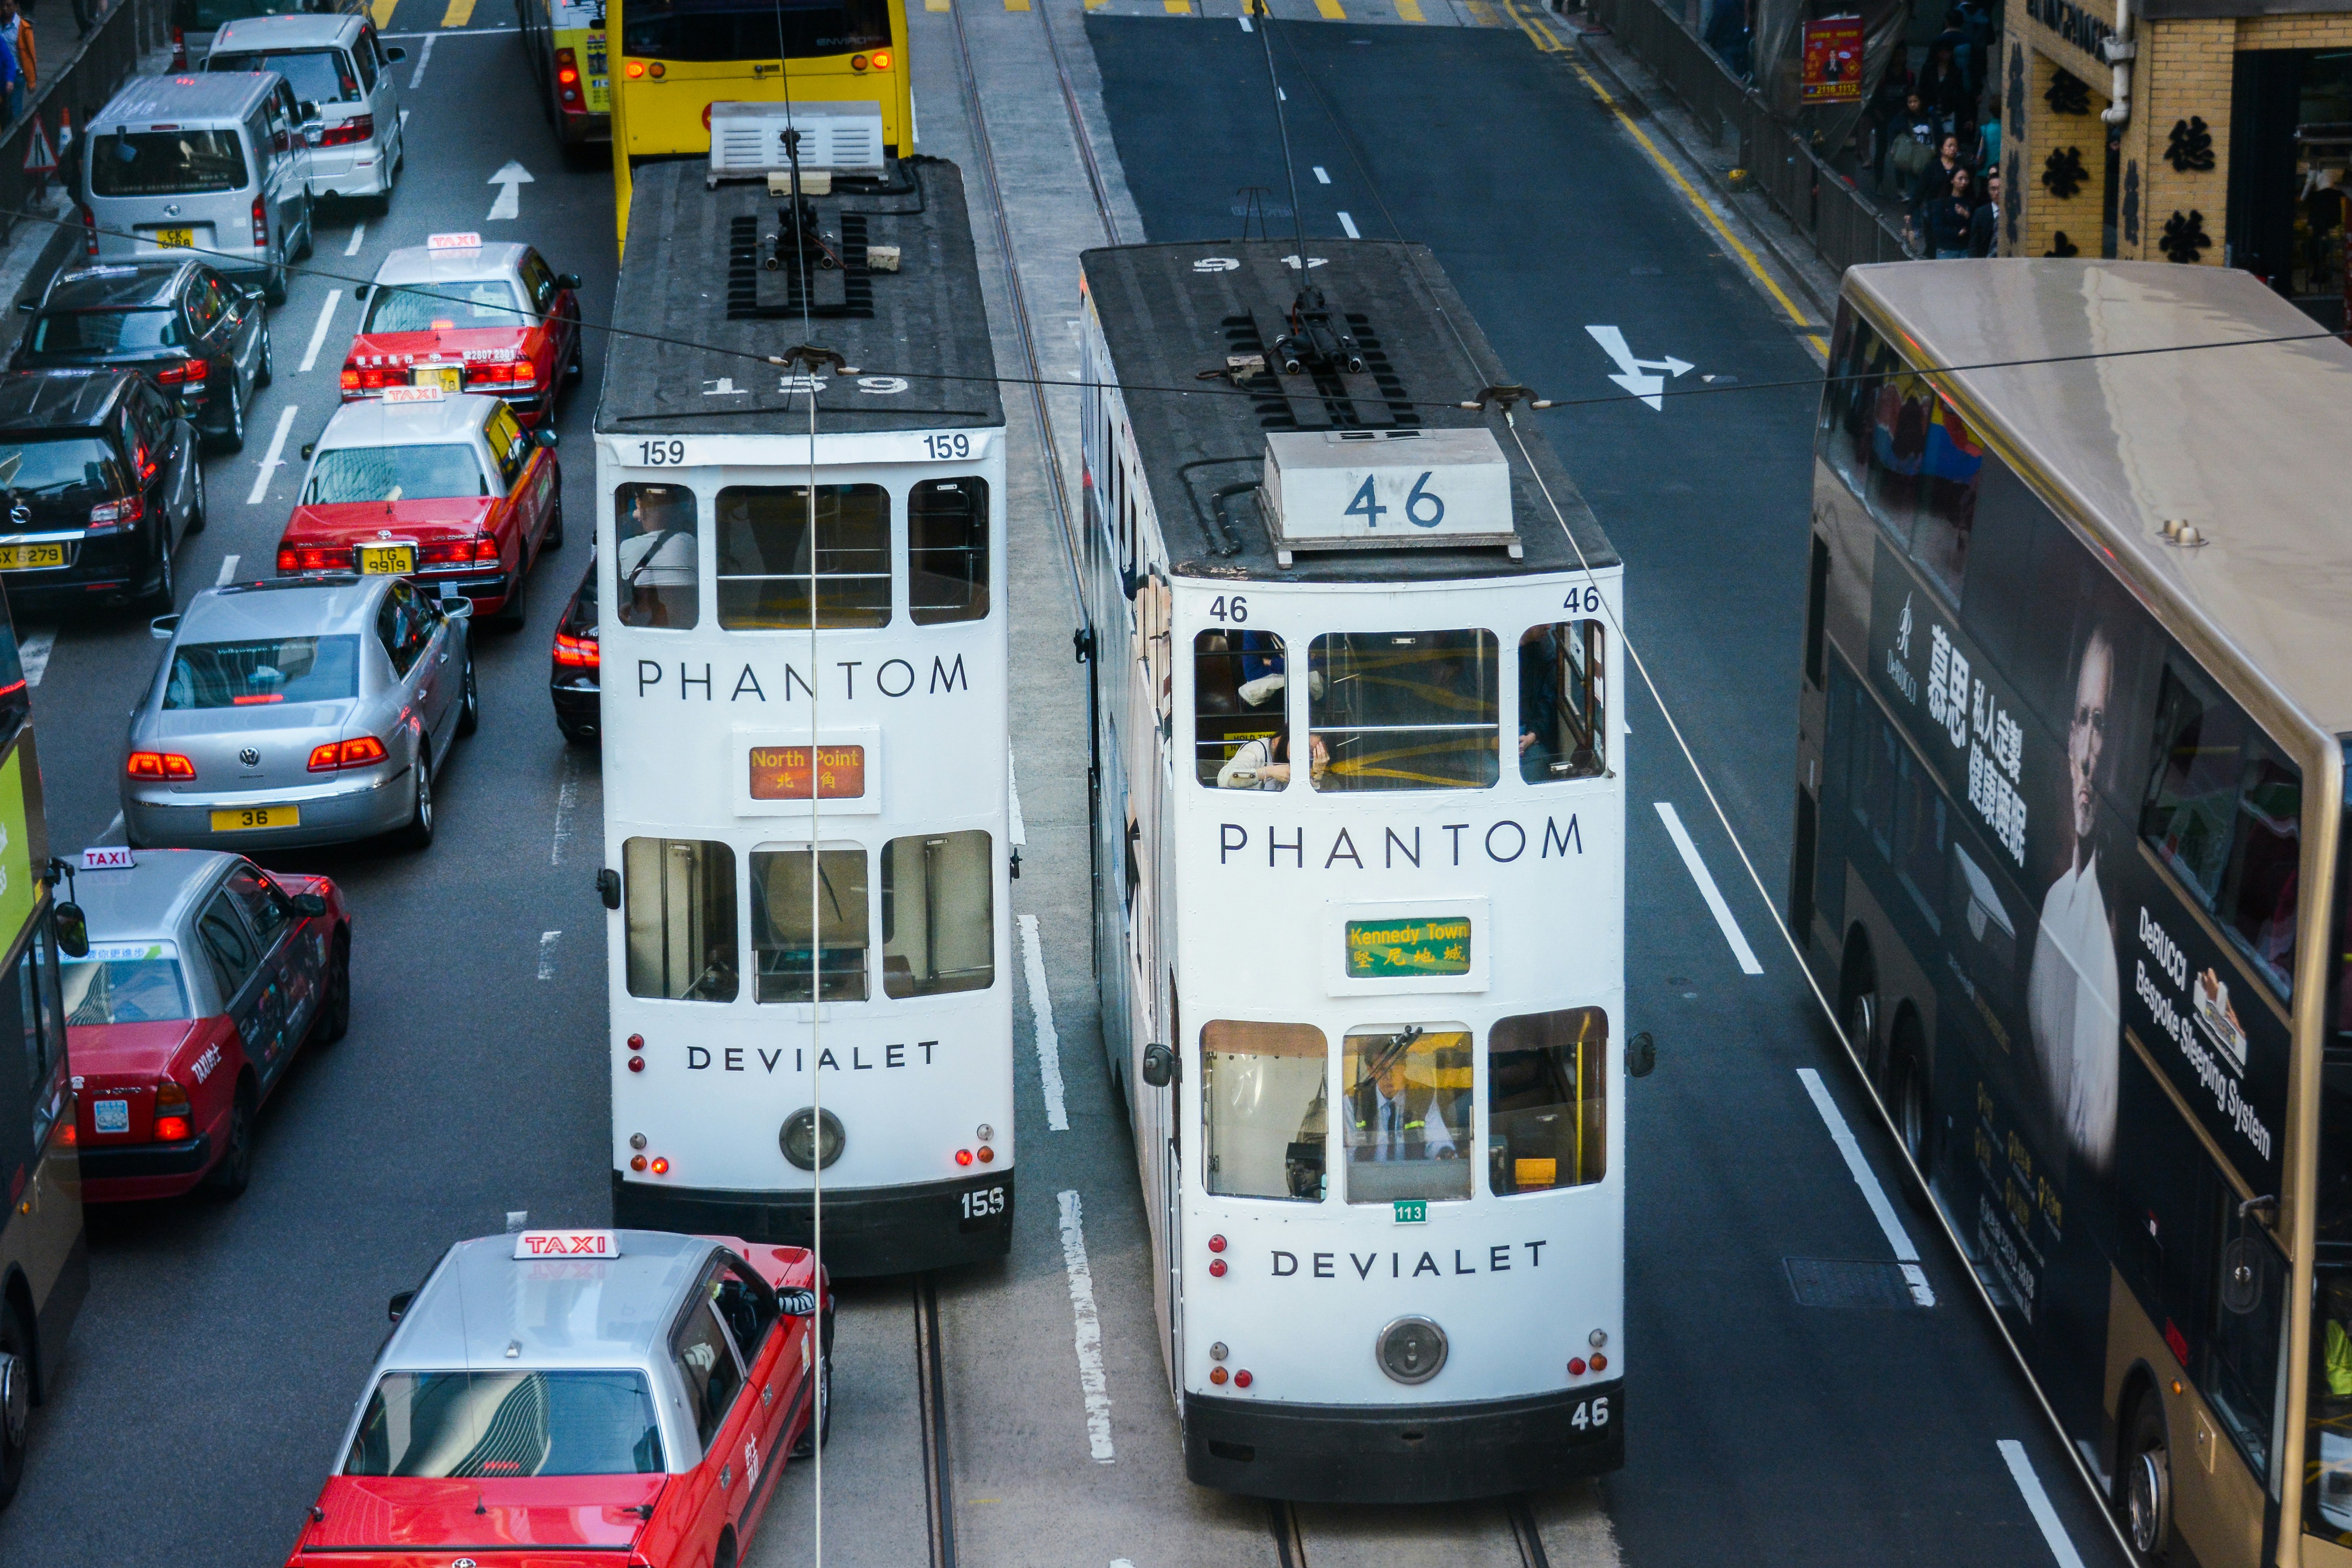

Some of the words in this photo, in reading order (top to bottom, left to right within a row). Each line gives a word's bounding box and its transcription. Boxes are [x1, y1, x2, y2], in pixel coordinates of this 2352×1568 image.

[817, 37, 866, 47] ENVIRO
[168, 231, 182, 239] CK
[433, 236, 475, 246] TAXI
[471, 350, 492, 360] 2807
[494, 349, 514, 359] 2301
[389, 388, 437, 401] TAXI
[703, 377, 908, 395] 159
[639, 441, 684, 465] 159
[923, 434, 969, 459] 159
[1344, 471, 1445, 528] 46
[0, 552, 11, 564] X
[17, 549, 58, 562] 6279
[369, 560, 406, 572] 9919
[377, 549, 397, 560] TG
[1209, 595, 1248, 623] 46
[1563, 586, 1599, 614] 46
[638, 653, 968, 702] PHANTOM
[1887, 649, 1917, 706] DeRUCCI
[1927, 624, 1970, 749] 慕思
[752, 750, 804, 767] North
[817, 750, 859, 766] Point
[776, 772, 835, 789] 北角
[1968, 739, 2027, 868] 健康睡眠
[242, 811, 268, 826] 36
[1220, 813, 1583, 869] PHANTOM
[86, 852, 126, 865] TAXI
[1351, 925, 1419, 945] Kennedy
[1426, 923, 1467, 940] Town
[1354, 944, 1466, 968] 堅尼地城
[2139, 906, 2187, 992] DeRUCCI
[687, 1040, 939, 1074] DEVIALET
[2136, 960, 2180, 1042] Bespoke
[2180, 1017, 2227, 1112] Sleeping
[2228, 1081, 2271, 1162] System
[961, 1187, 1005, 1219] 159
[1397, 1206, 1422, 1219] 113
[525, 1237, 605, 1254] TAXI
[1271, 1239, 1546, 1280] DEVIALET
[1571, 1397, 1609, 1431] 46
